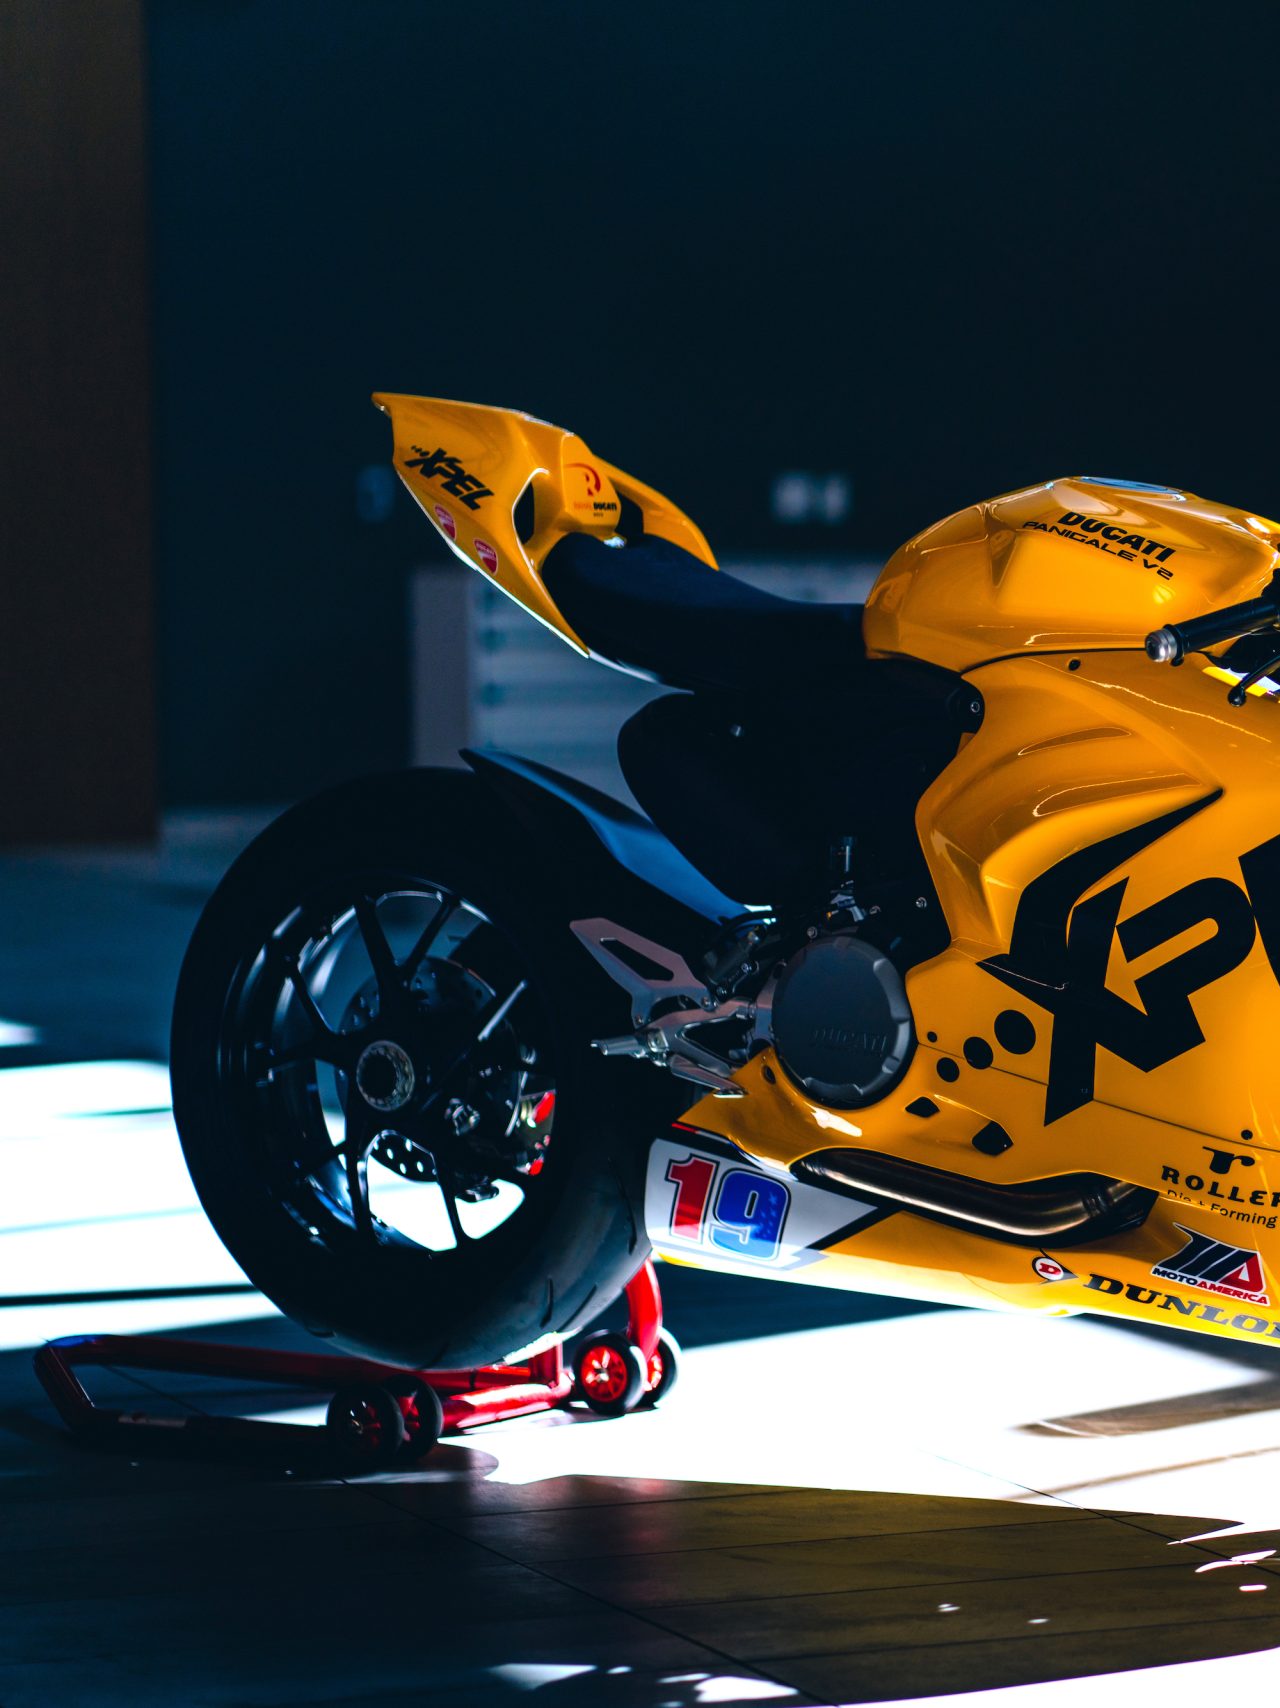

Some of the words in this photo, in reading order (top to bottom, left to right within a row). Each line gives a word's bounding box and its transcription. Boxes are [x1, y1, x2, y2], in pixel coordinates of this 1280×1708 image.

[405, 447, 494, 510] XPEL
[1022, 521, 1138, 562] PANIGALE
[1142, 558, 1174, 580] V2
[1058, 511, 1176, 563] DUCATI
[664, 1152, 792, 1262] 19
[1211, 1203, 1278, 1229] Forming
[1038, 1262, 1062, 1276] D
[1152, 1267, 1268, 1305] MOTOAMERICA
